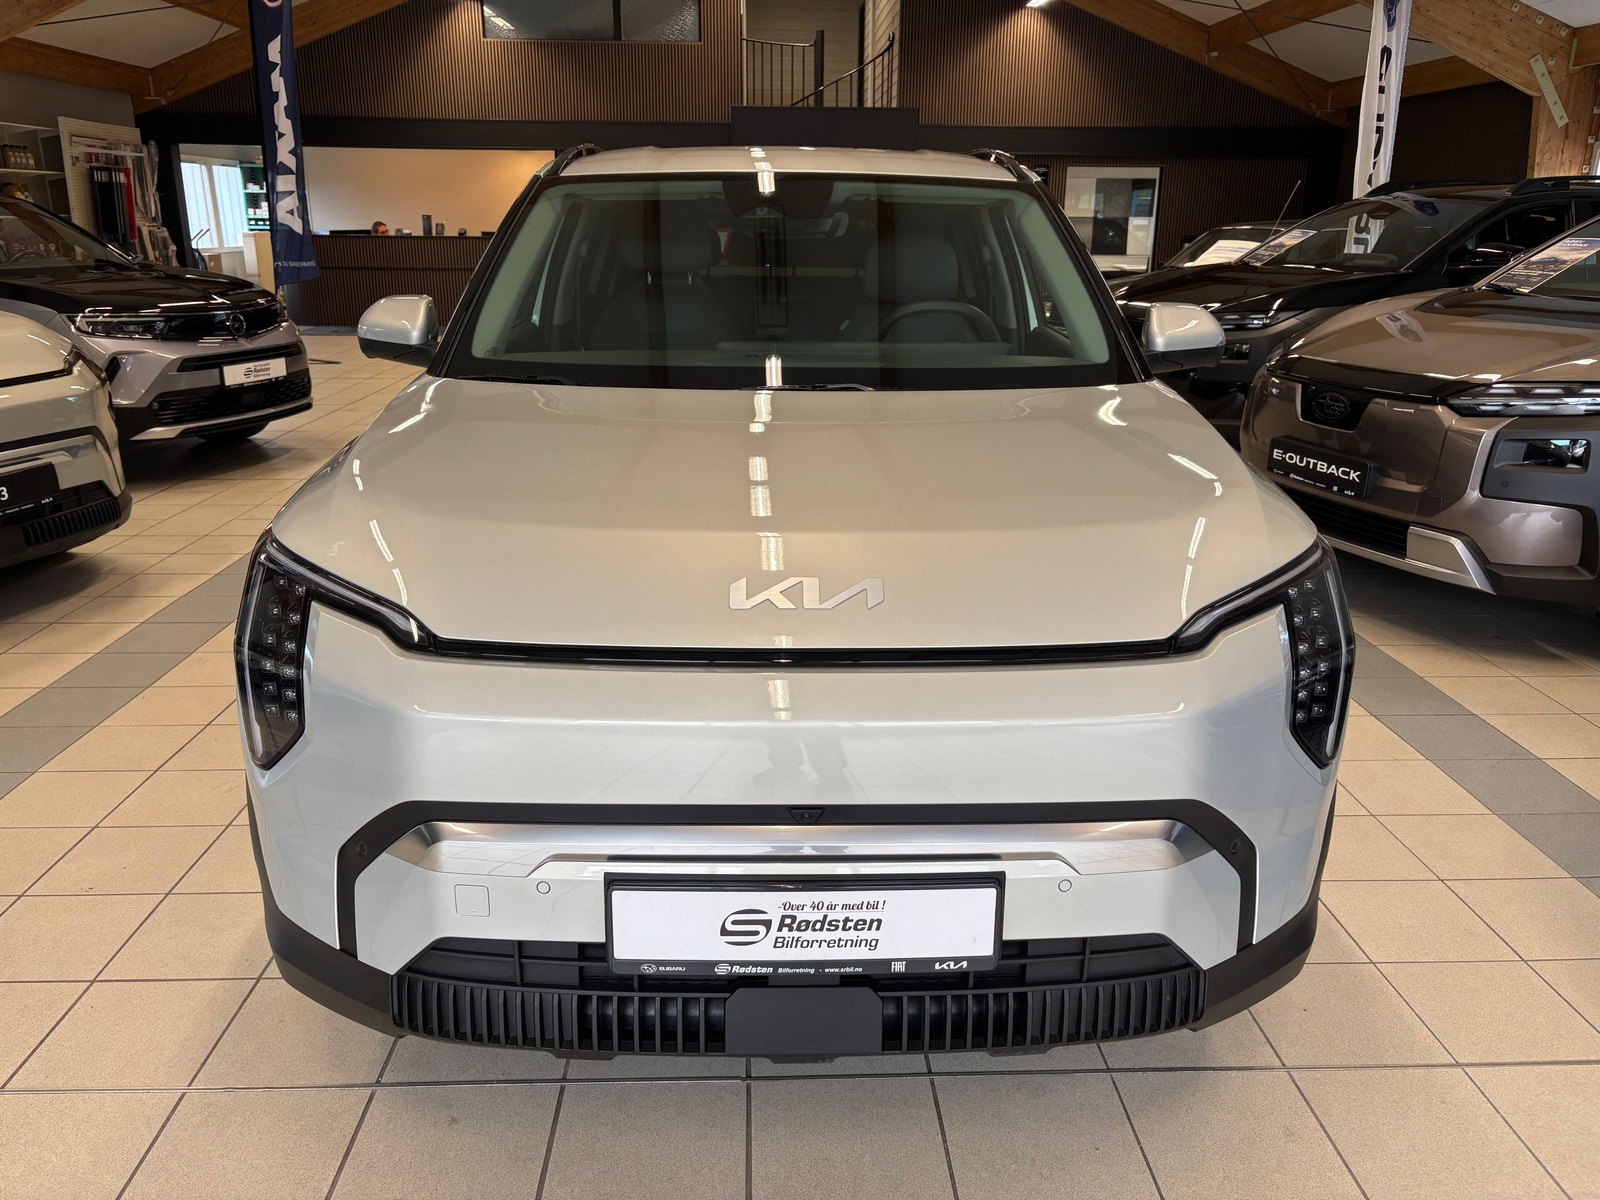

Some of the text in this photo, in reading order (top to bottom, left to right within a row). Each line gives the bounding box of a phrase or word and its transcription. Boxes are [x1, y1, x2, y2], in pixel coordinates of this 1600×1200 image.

[729, 576, 885, 610] KIA
[809, 901, 825, 911] 40
[826, 900, 839, 911] år
[841, 901, 863, 911] med
[776, 914, 883, 932] Rødsten
[773, 935, 879, 951] Bilforretning
[732, 965, 773, 974] Rødsten
[777, 966, 815, 975] Bilforretning
[824, 966, 863, 974] www.srbil.no
[891, 961, 906, 972] FIAT
[934, 960, 968, 970] KIA
